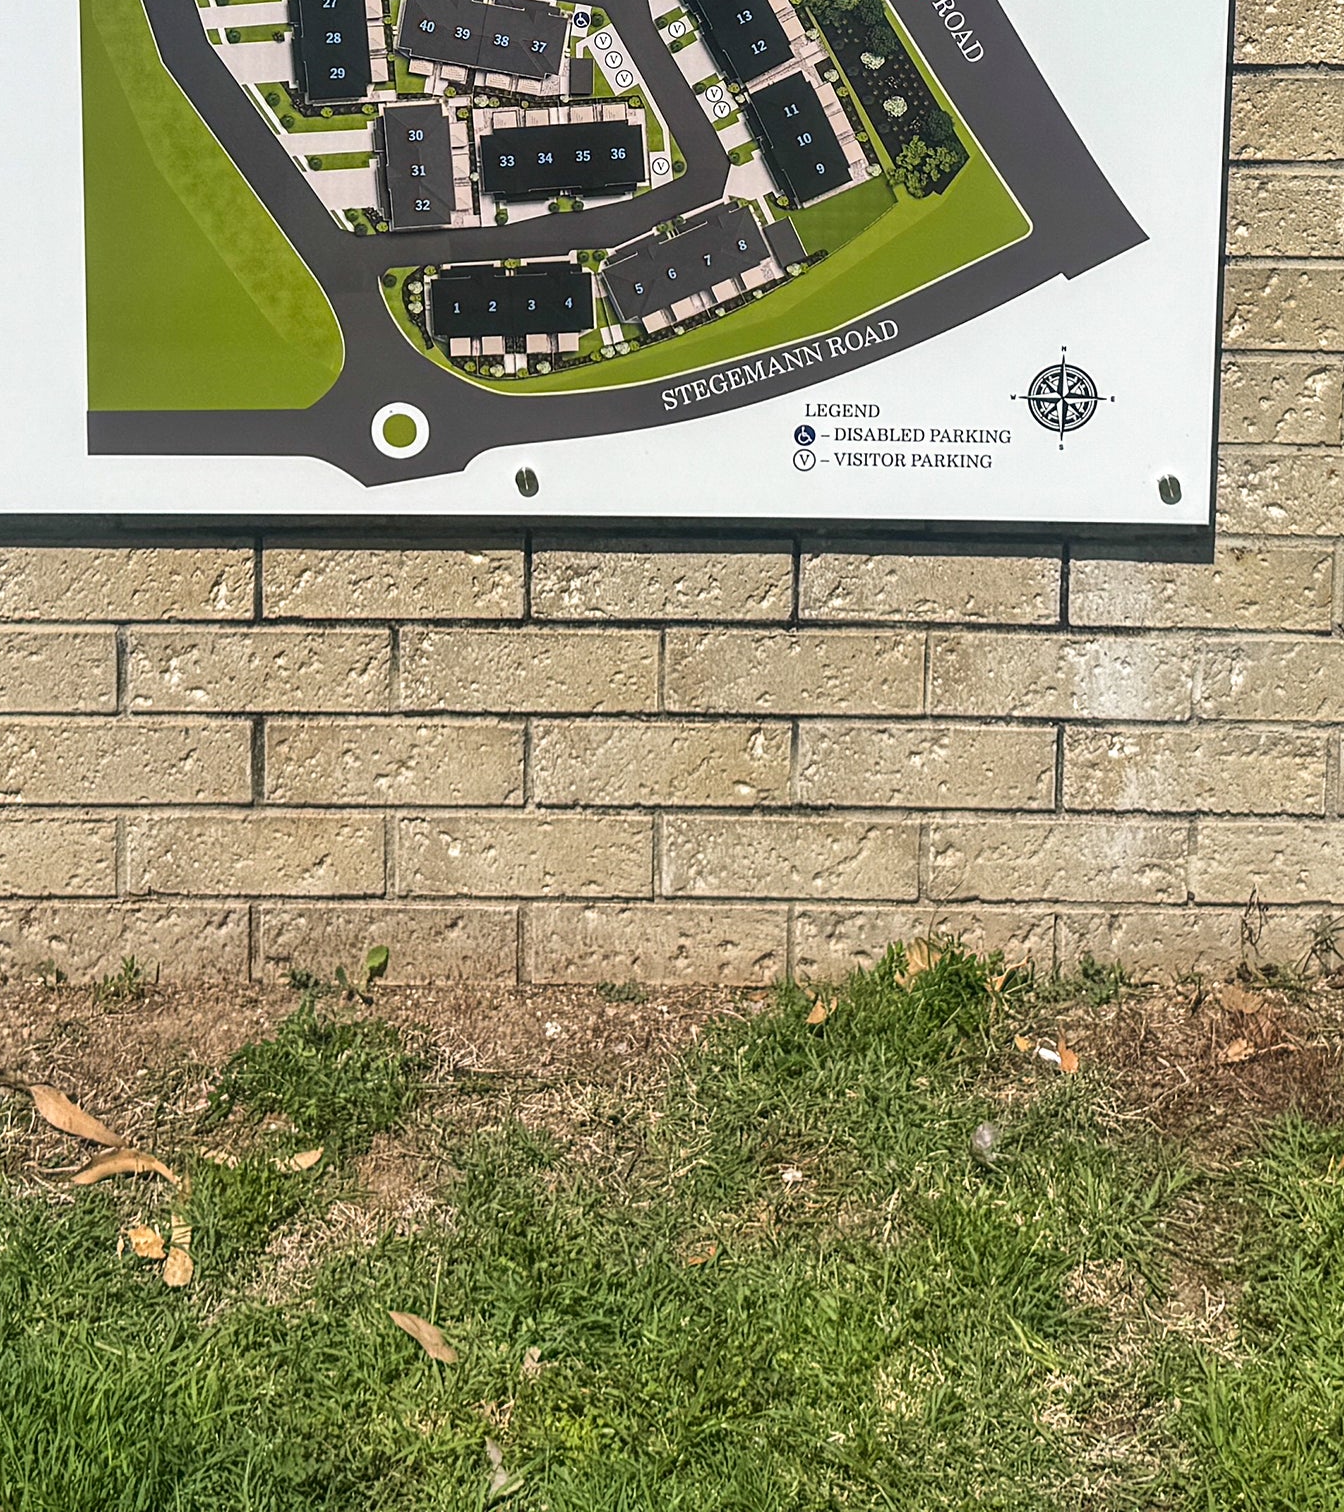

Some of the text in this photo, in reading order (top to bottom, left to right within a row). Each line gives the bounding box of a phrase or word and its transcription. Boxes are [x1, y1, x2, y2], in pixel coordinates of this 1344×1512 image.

[736, 10, 753, 25] 13
[326, 32, 342, 44] 28
[419, 19, 547, 53] 40 39 38 37
[751, 40, 768, 55] 12
[329, 67, 346, 79] 29
[783, 103, 800, 118] 11
[408, 129, 424, 141] 30
[797, 132, 812, 147] 10
[499, 147, 626, 167] 33 34 35 36
[411, 165, 426, 176] 31
[816, 163, 825, 174] 9
[415, 199, 431, 211] 32
[738, 239, 748, 251] 8
[703, 254, 711, 266] 7
[668, 268, 677, 279] 6
[634, 282, 644, 294] 5
[454, 297, 573, 314] 1 2 3 4
[662, 320, 899, 410] STEGEMANN ROAD
[806, 404, 879, 417] LEGEND
[835, 428, 924, 442] DISABLED
[931, 429, 1010, 443] PARKING
[834, 453, 905, 467] VISITOR
[912, 454, 991, 468] PARKING
